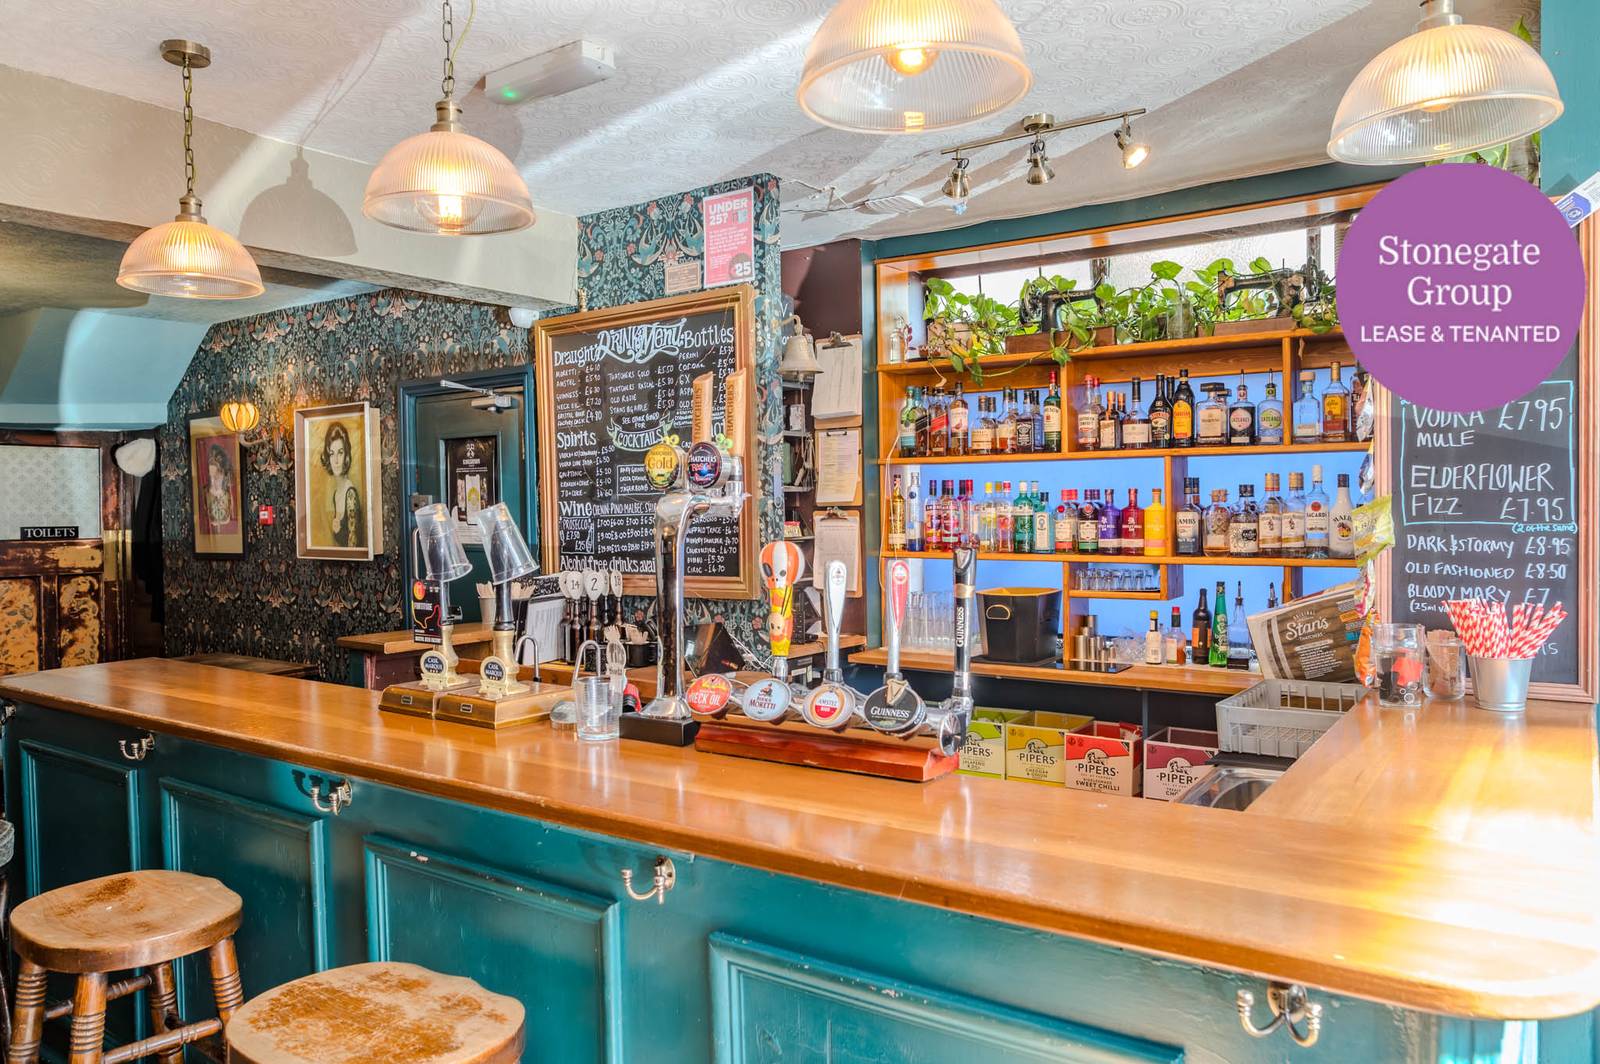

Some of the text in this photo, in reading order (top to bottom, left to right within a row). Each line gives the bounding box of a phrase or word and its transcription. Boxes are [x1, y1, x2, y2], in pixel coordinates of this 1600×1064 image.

[709, 198, 748, 215] UNDER
[710, 213, 728, 225] 25?
[684, 326, 735, 349] Bottles
[556, 369, 576, 378] MORETTI
[556, 391, 579, 401] GUINNESS
[1498, 398, 1566, 431] £7.95
[557, 430, 597, 449] Spirits
[617, 428, 662, 448] COCKTAILS
[1416, 430, 1476, 448] MULE
[648, 456, 674, 470] Gold
[688, 455, 717, 463] THATCHERS
[1410, 462, 1554, 493] ELDERFLOWER
[558, 500, 592, 516] Wine
[1412, 493, 1566, 522] FIZZ £7.95
[24, 527, 76, 538] TOILETS
[1407, 534, 1448, 552] DARK
[560, 555, 586, 571] Alcohol
[586, 556, 608, 572] free
[609, 556, 639, 572] drinks
[1405, 562, 1430, 574] OLD
[1434, 562, 1515, 580] FASHIONED
[592, 578, 598, 591] 2
[1408, 583, 1550, 605] BLOODY MARY £7
[956, 606, 964, 648] GUINNESS
[1286, 616, 1329, 640] Stan's
[689, 693, 721, 706] NECK OIL
[750, 699, 776, 710] MORETTI
[870, 706, 911, 718] GUINNESS
[958, 746, 991, 758] PIPERS
[1019, 752, 1056, 765] PIPERS
[1078, 762, 1116, 776] PIPERS
[1076, 780, 1120, 792] SWEET CHILLI
